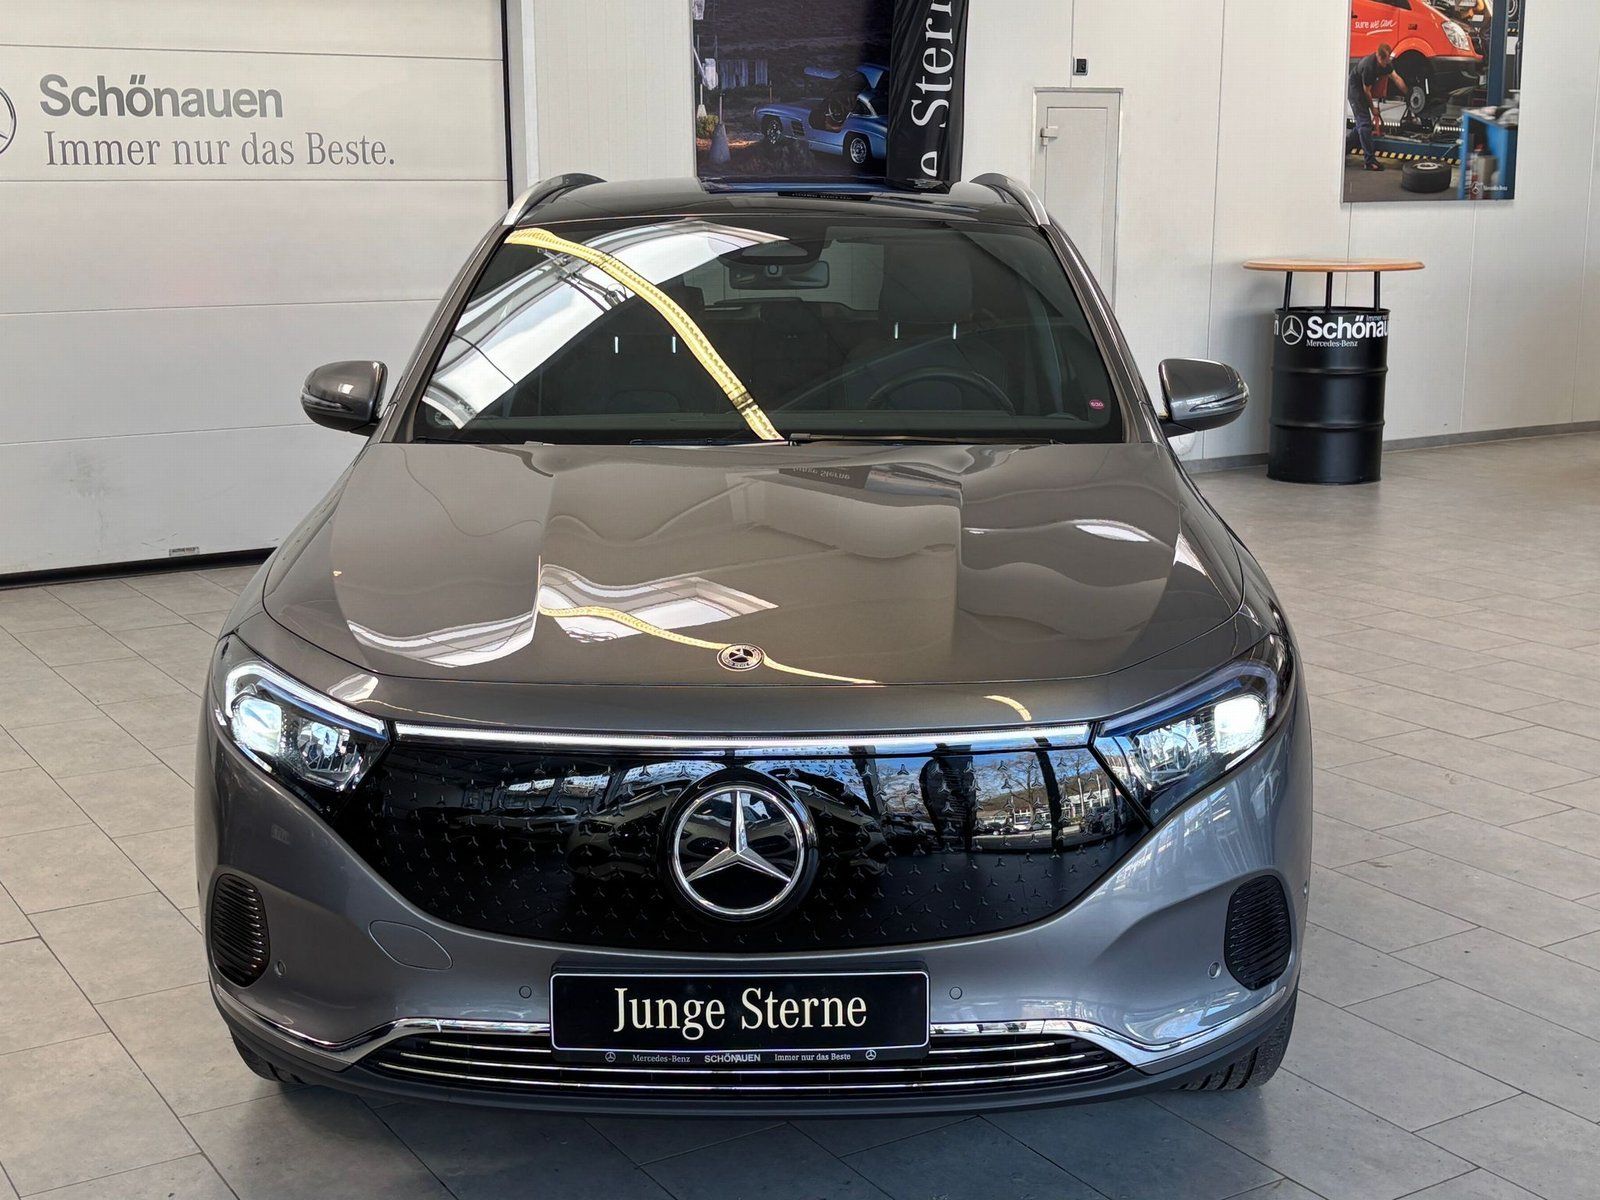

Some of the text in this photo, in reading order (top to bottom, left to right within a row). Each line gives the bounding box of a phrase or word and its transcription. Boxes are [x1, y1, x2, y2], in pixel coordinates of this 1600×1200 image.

[39, 73, 284, 119] Schönauen
[44, 130, 396, 166] Immer nur das Beste.
[1306, 339, 1359, 347] Mercedes-Benz
[613, 987, 867, 1041] Junge Sterne
[632, 1054, 691, 1063] Mercedes-Benz
[704, 1052, 761, 1063] SCHÖNAUEN
[774, 1053, 800, 1061] Immer
[816, 1052, 829, 1061] das
[831, 1052, 851, 1061] Beste
